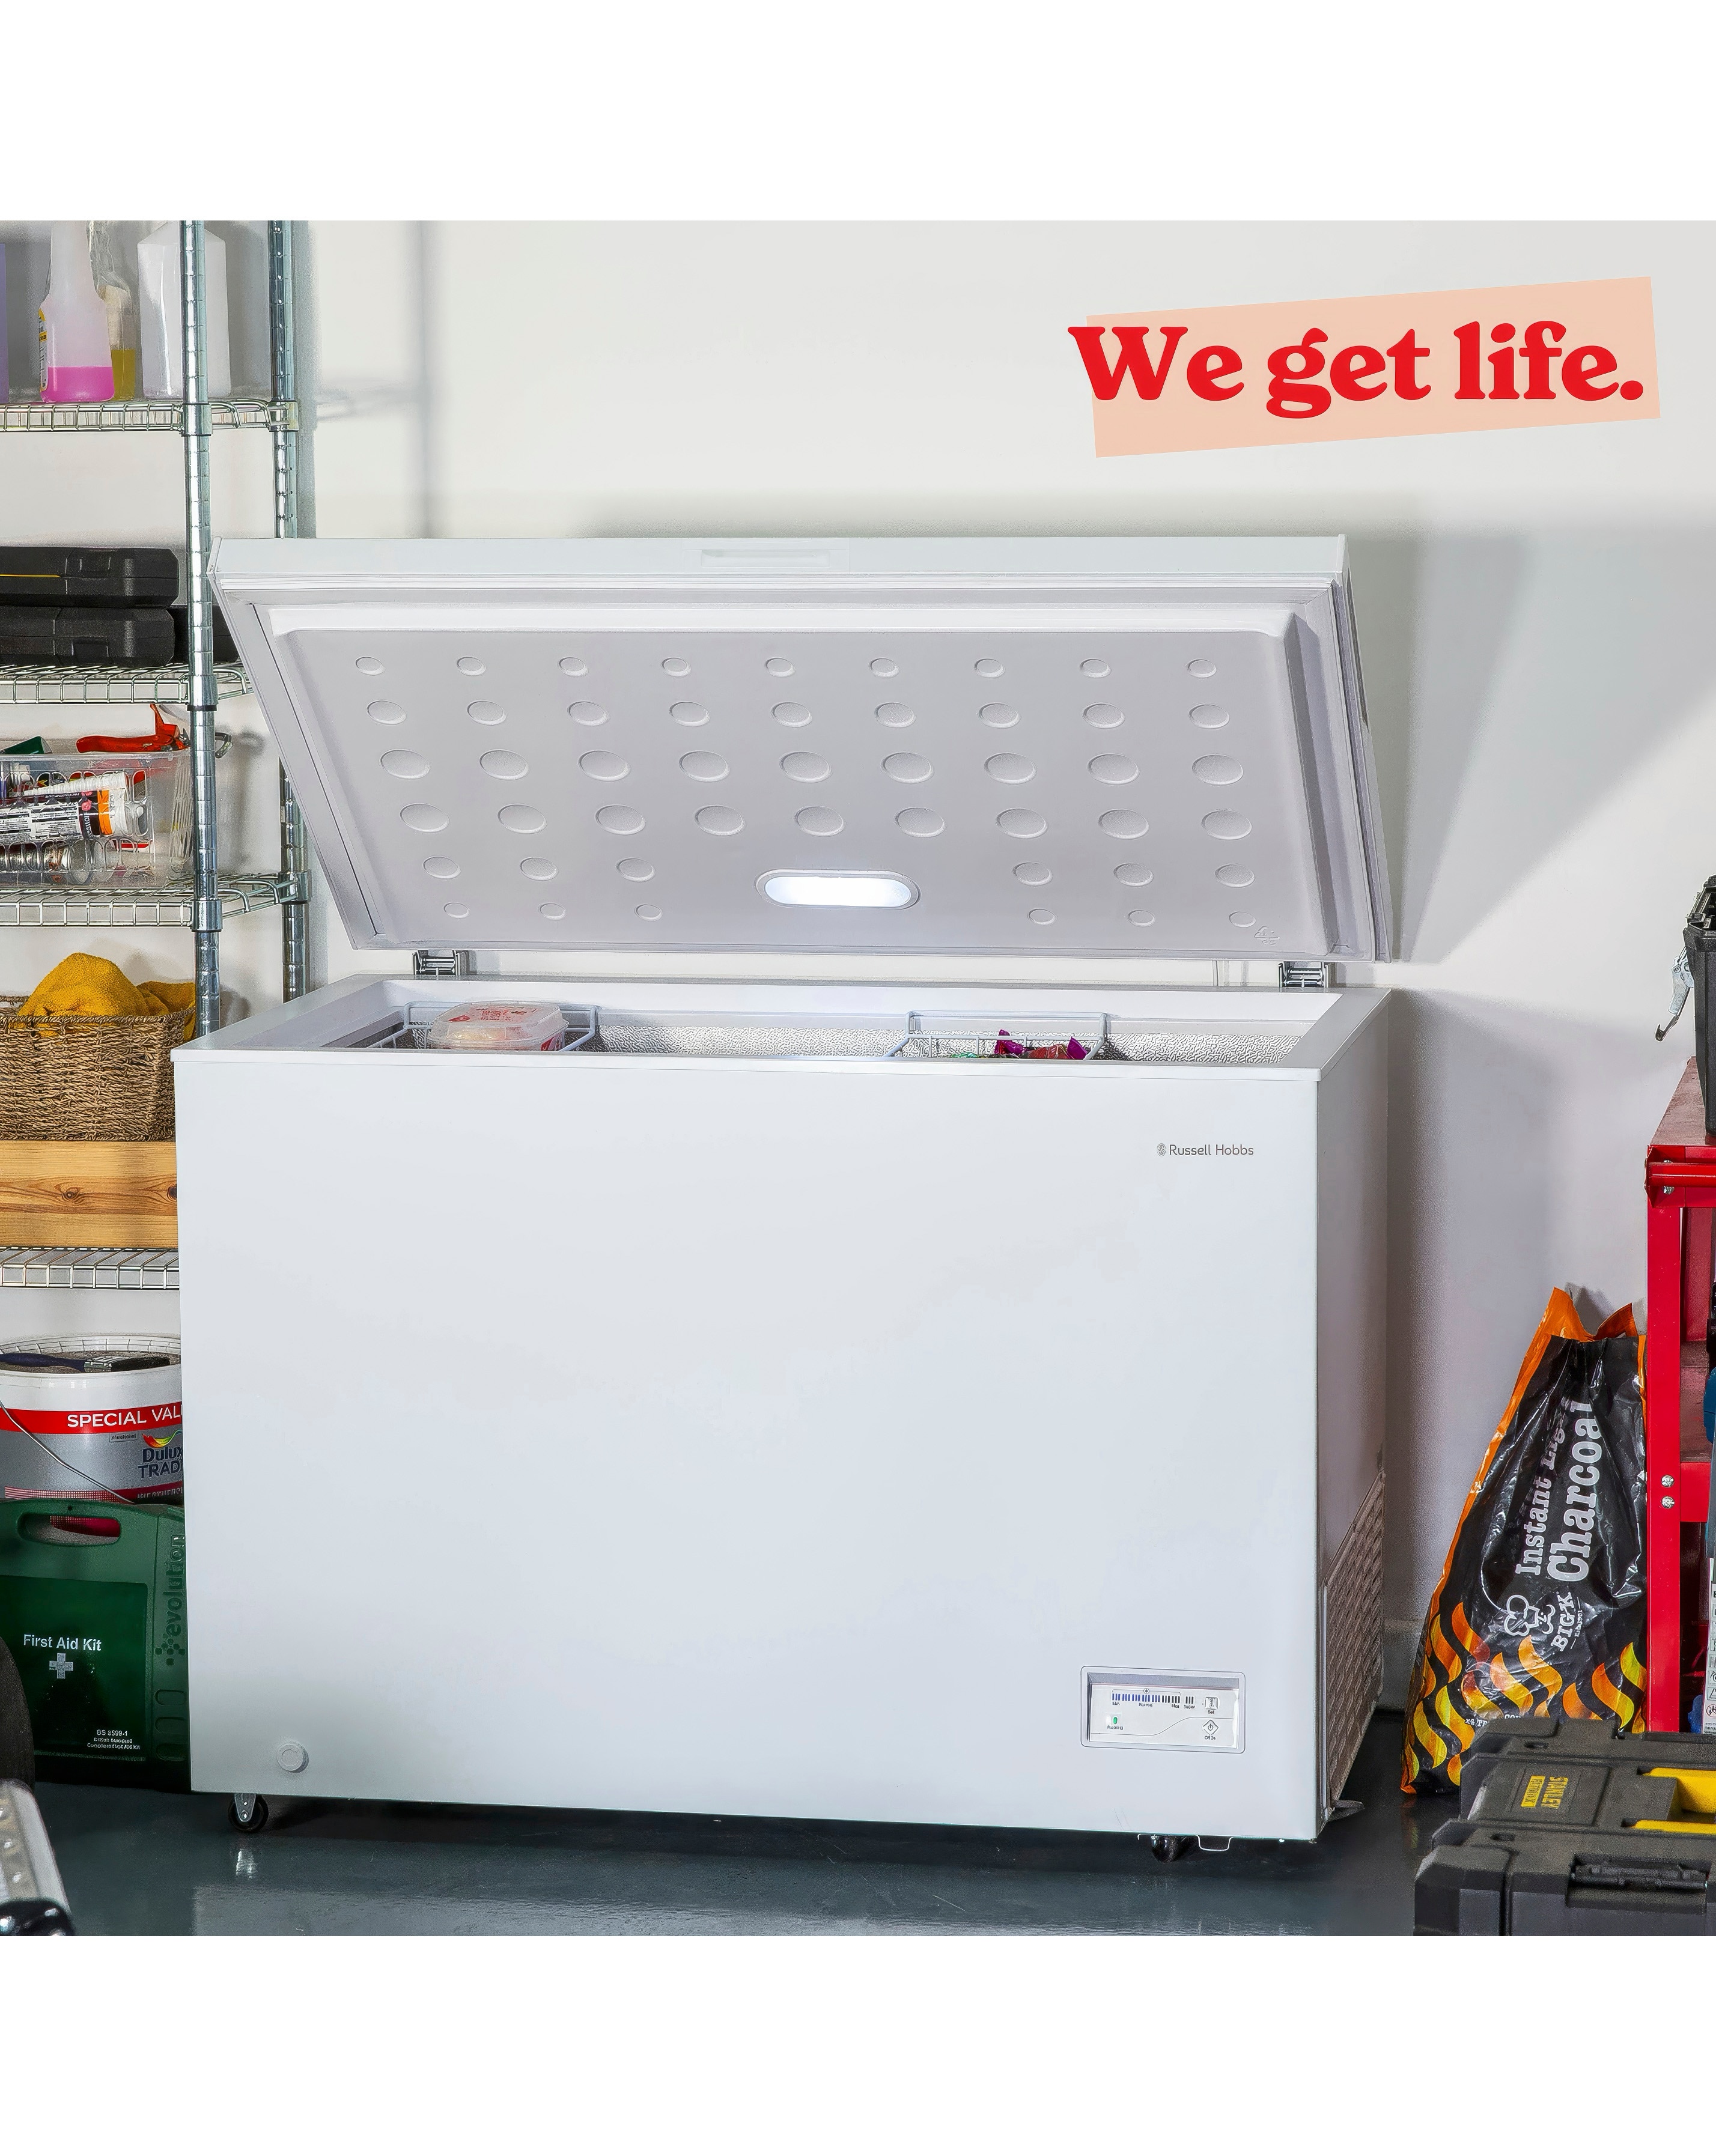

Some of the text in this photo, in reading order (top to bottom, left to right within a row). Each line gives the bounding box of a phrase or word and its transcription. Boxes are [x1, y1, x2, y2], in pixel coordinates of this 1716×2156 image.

[1169, 1144, 1254, 1156] Russell Hobbs
[67, 1404, 183, 1428] SPECIAL VAL
[137, 1460, 183, 1479] TRAD
[1547, 1400, 1602, 1582] Charcoal
[1515, 1476, 1552, 1576] Instant
[162, 1534, 186, 1638] evolution
[23, 1634, 102, 1651] First Aid Kit
